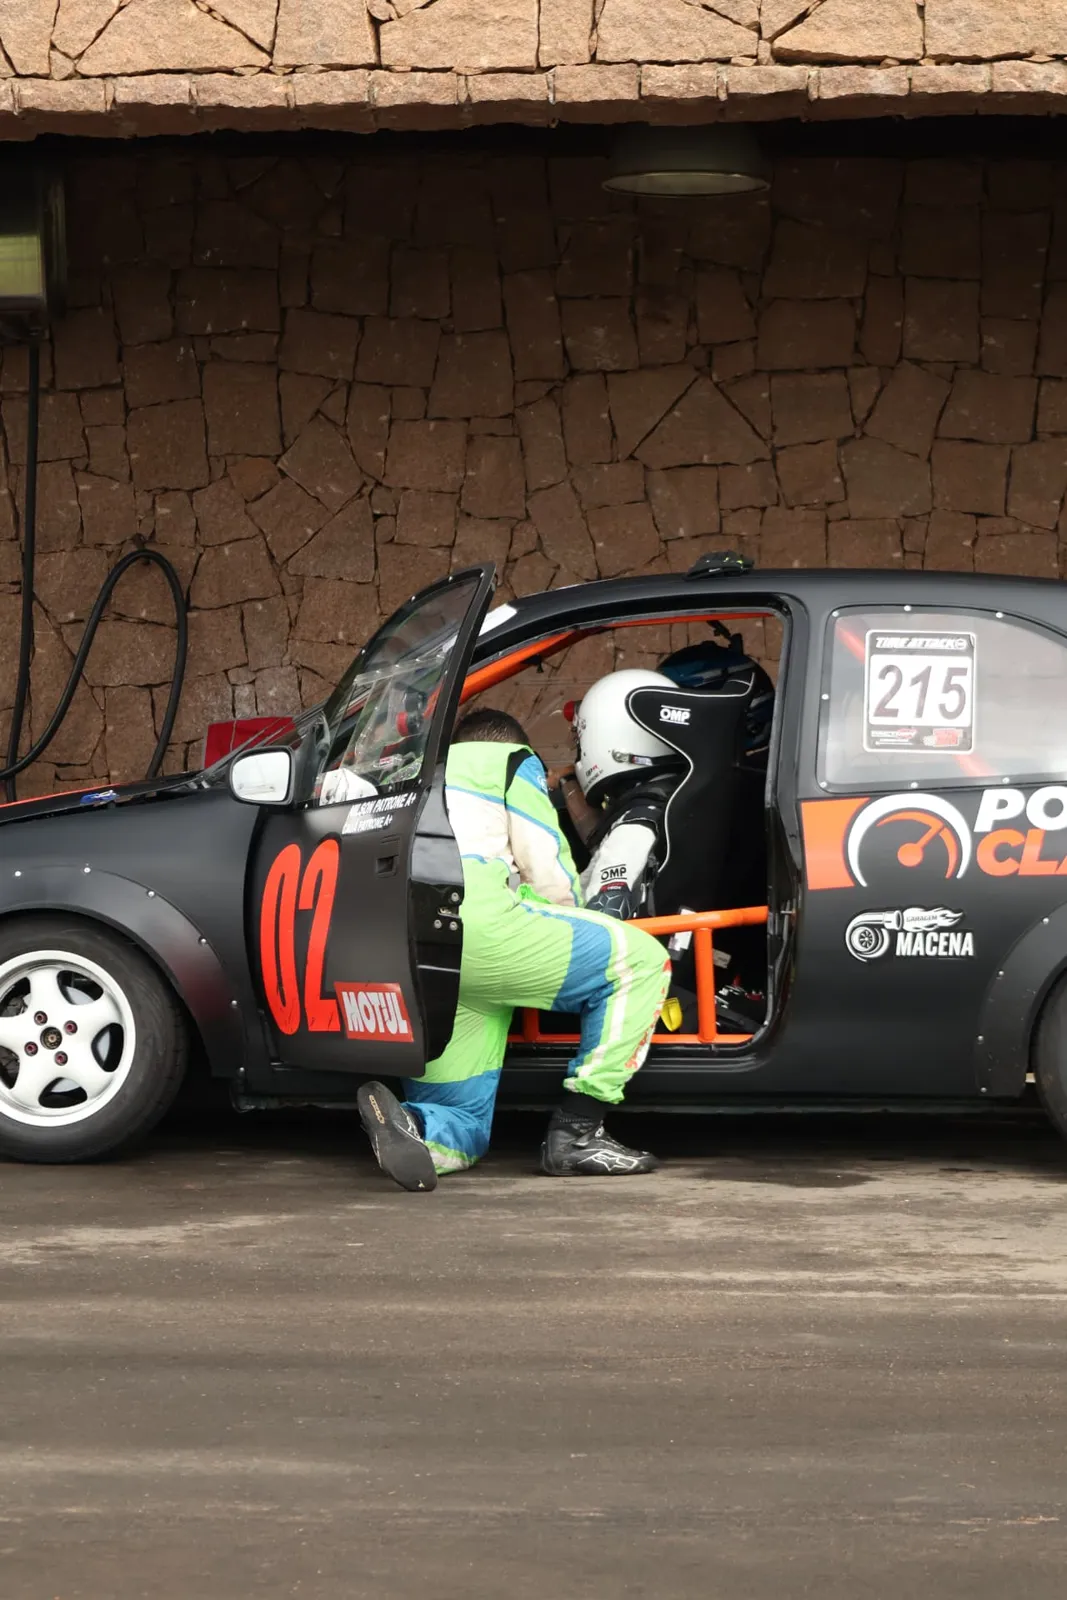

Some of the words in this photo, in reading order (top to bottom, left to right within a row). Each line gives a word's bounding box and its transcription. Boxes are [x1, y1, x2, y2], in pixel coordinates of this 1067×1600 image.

[873, 664, 968, 720] 215
[660, 708, 690, 722] OMP
[601, 866, 627, 880] OMP
[260, 838, 340, 1036] 02
[895, 931, 974, 956] MACENA
[341, 990, 409, 1035] MOTUL
